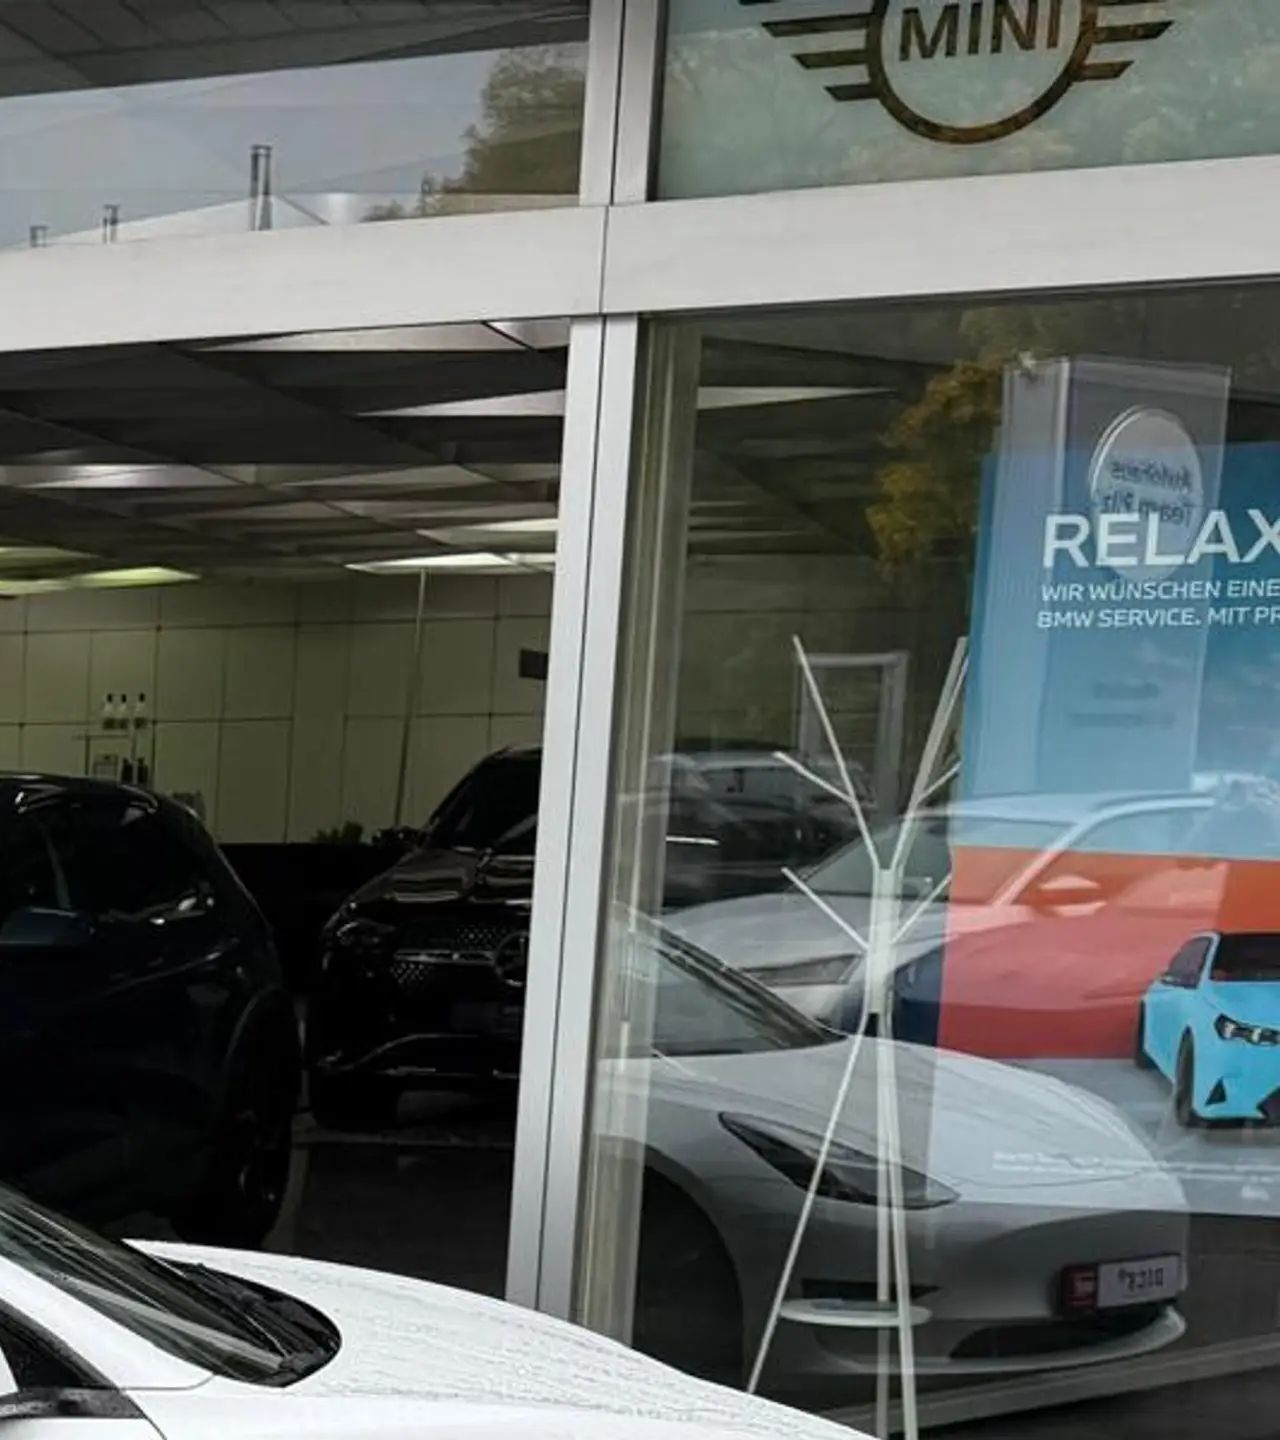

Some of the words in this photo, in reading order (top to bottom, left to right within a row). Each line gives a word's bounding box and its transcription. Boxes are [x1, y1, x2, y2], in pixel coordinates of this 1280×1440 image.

[899, 0, 1062, 61] MINI
[1042, 508, 1280, 569] RELAX
[1041, 582, 1085, 601] WIR
[1089, 574, 1221, 601] WÜNSCHEN
[1227, 577, 1280, 598] EINE
[1037, 609, 1094, 628] BMW
[1096, 606, 1201, 628] SERVICE.
[1207, 606, 1251, 625] MIT
